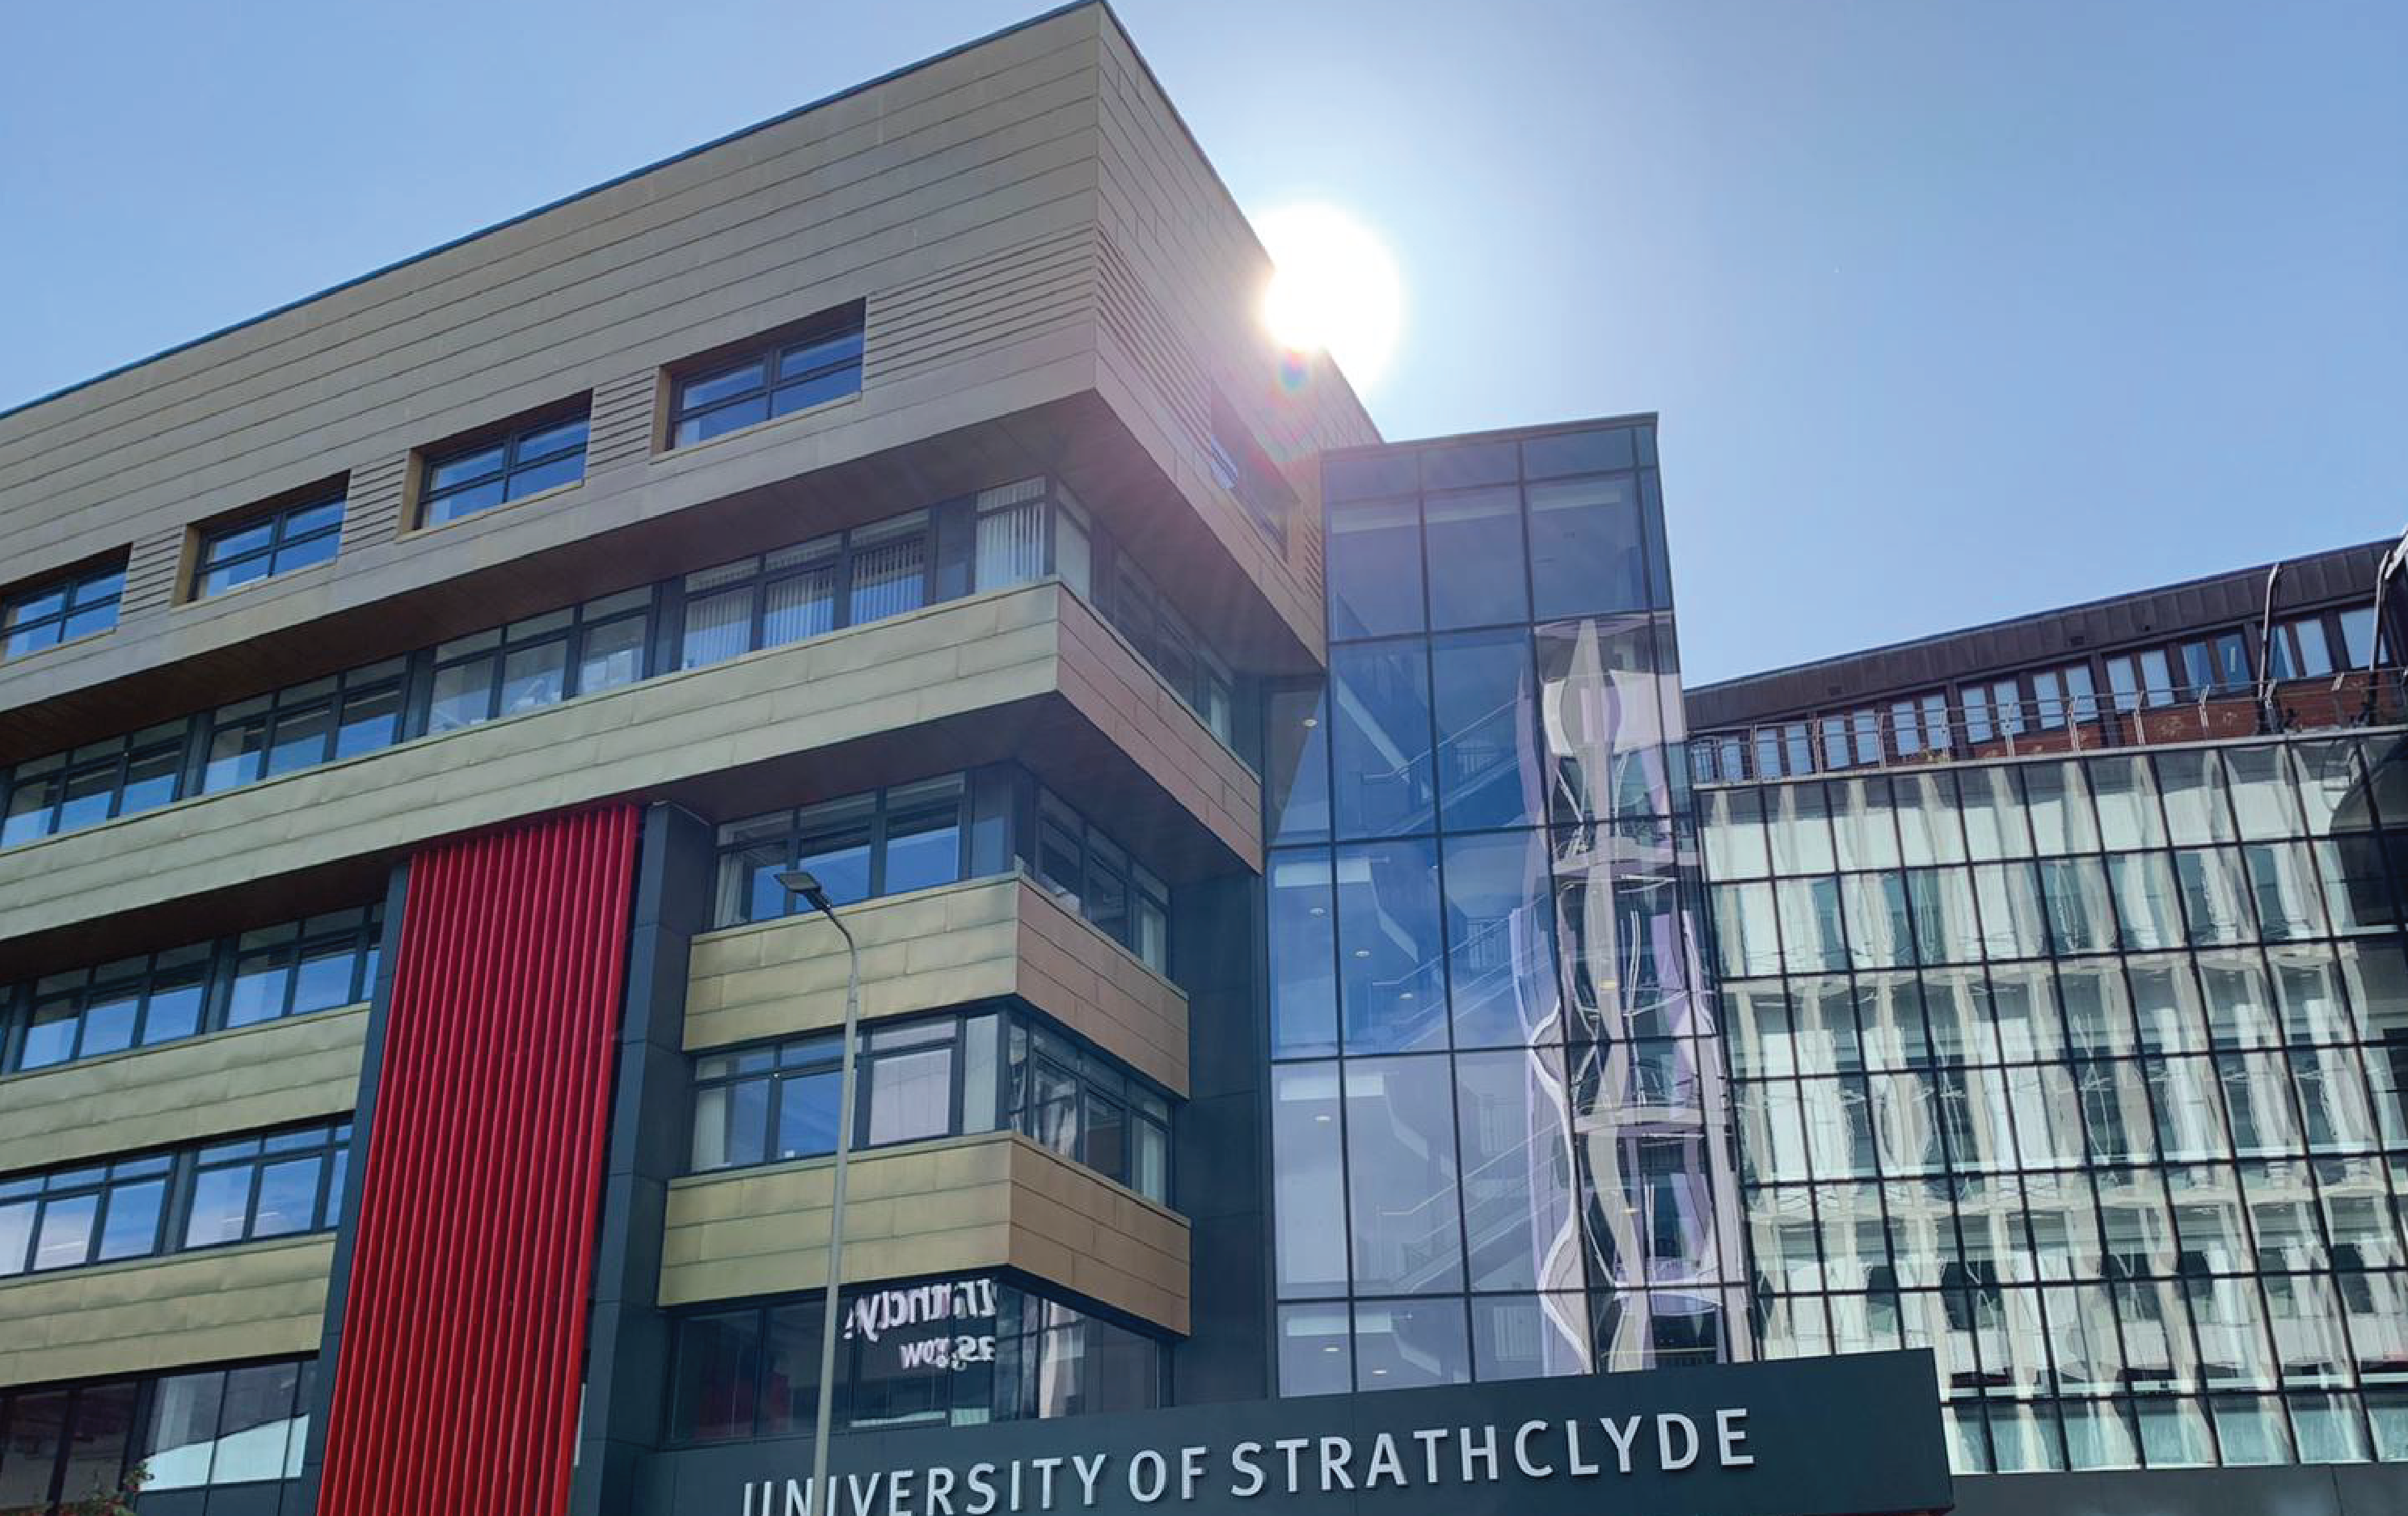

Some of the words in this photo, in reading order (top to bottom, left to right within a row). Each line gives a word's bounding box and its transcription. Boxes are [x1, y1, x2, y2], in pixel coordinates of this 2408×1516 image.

[743, 1454, 1106, 1516] UNIVERSITY
[1128, 1446, 1207, 1501] OF
[1231, 1408, 1755, 1497] STRATHCLYDE
